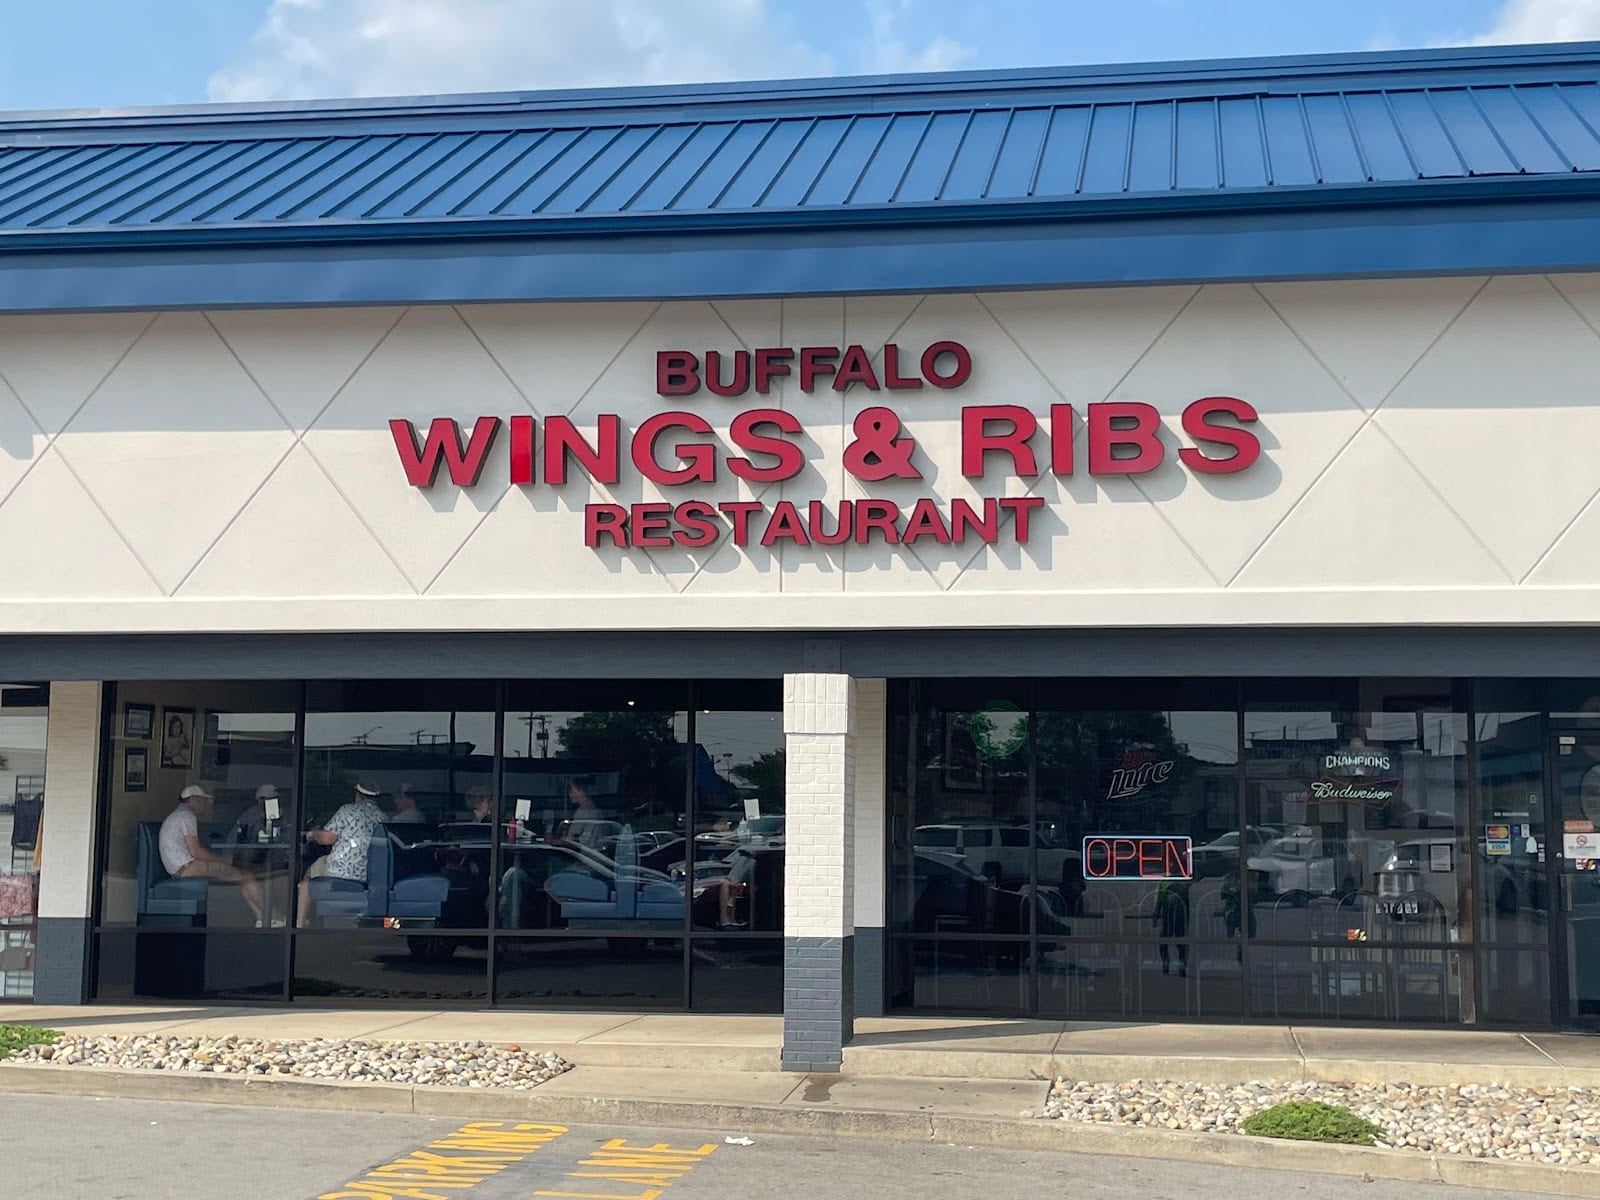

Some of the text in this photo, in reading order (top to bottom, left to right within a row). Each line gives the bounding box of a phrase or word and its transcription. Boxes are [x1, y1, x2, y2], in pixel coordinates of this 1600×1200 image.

[657, 340, 972, 396] BUFFALO
[389, 396, 1261, 487] WINGS & RIBS
[585, 497, 1045, 548] RESTAURANT
[1106, 760, 1174, 800] Lite
[1325, 755, 1391, 770] CHAMPIONS
[1311, 782, 1393, 800] Budweiser
[1086, 838, 1191, 879] OPEN
